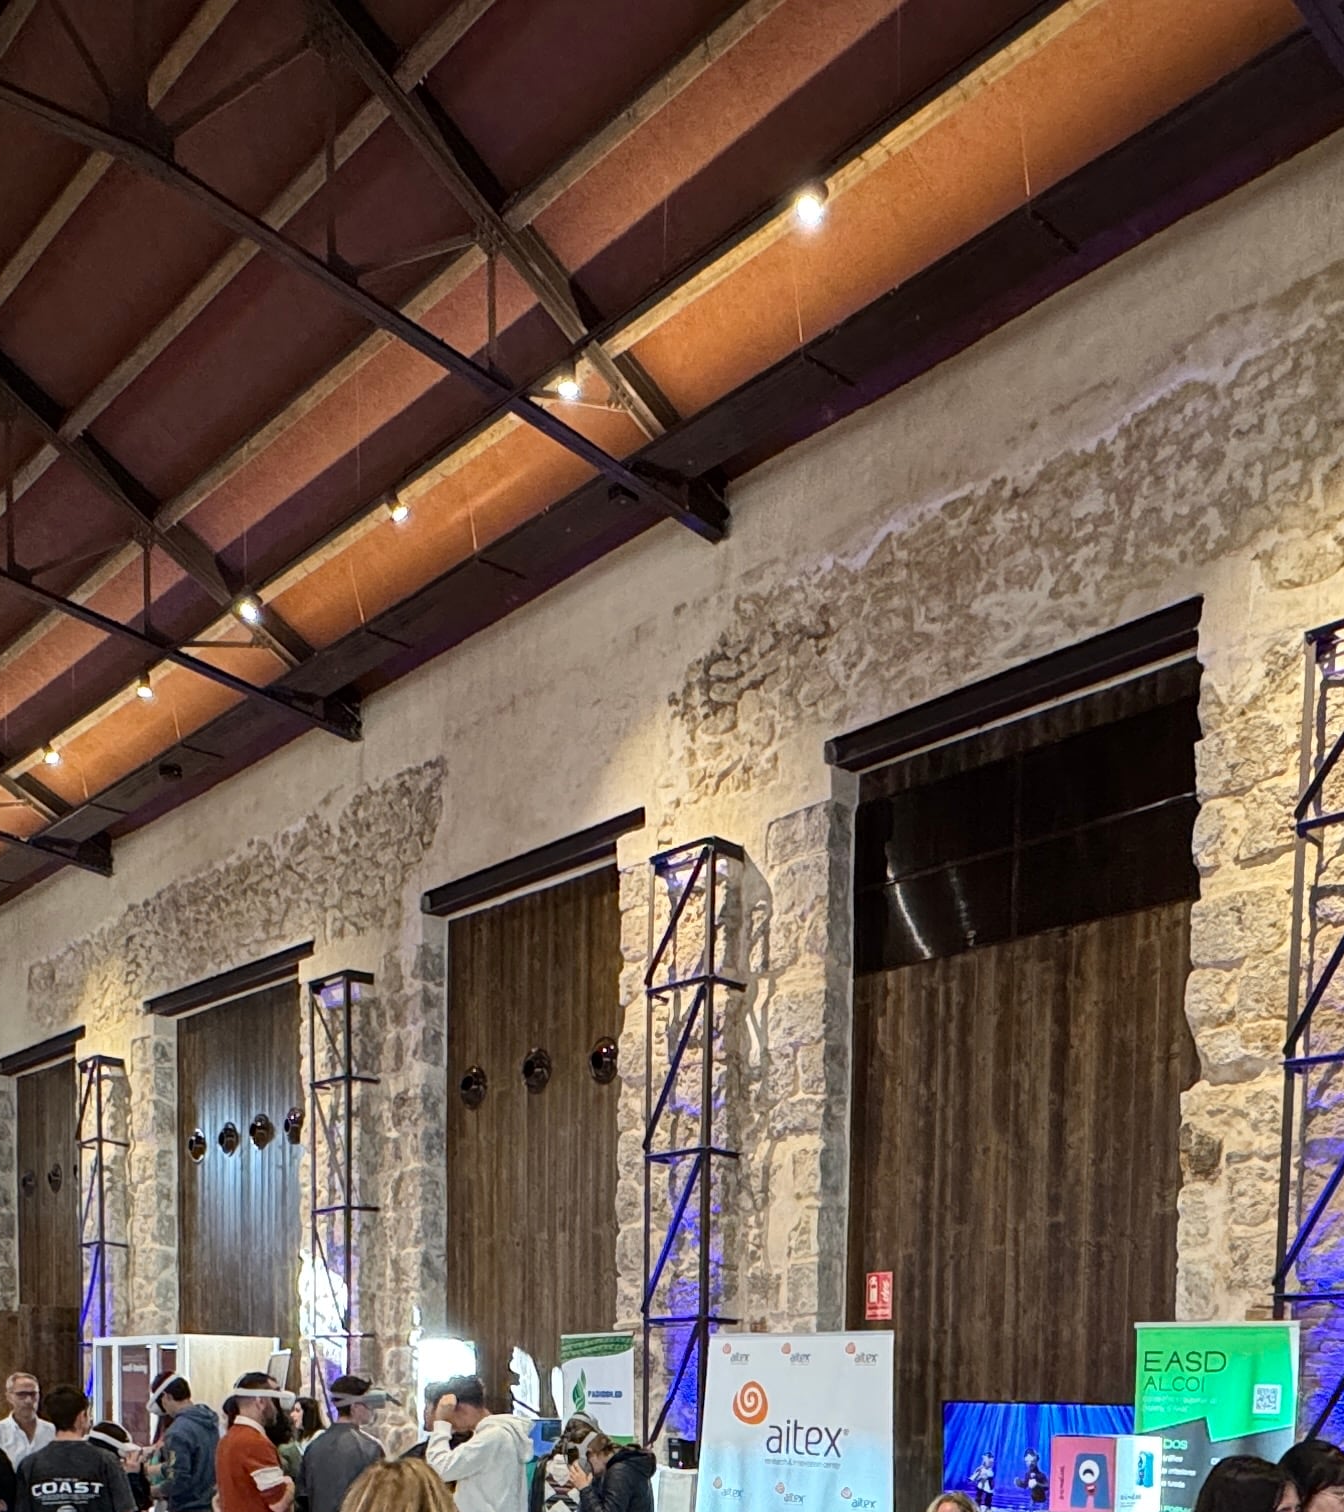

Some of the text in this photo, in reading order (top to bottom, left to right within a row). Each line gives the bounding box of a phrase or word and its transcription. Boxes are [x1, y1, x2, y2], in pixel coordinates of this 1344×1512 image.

[1144, 1350, 1227, 1372] EASD
[1143, 1376, 1204, 1392] ALCOI
[31, 1481, 104, 1497] COAST
